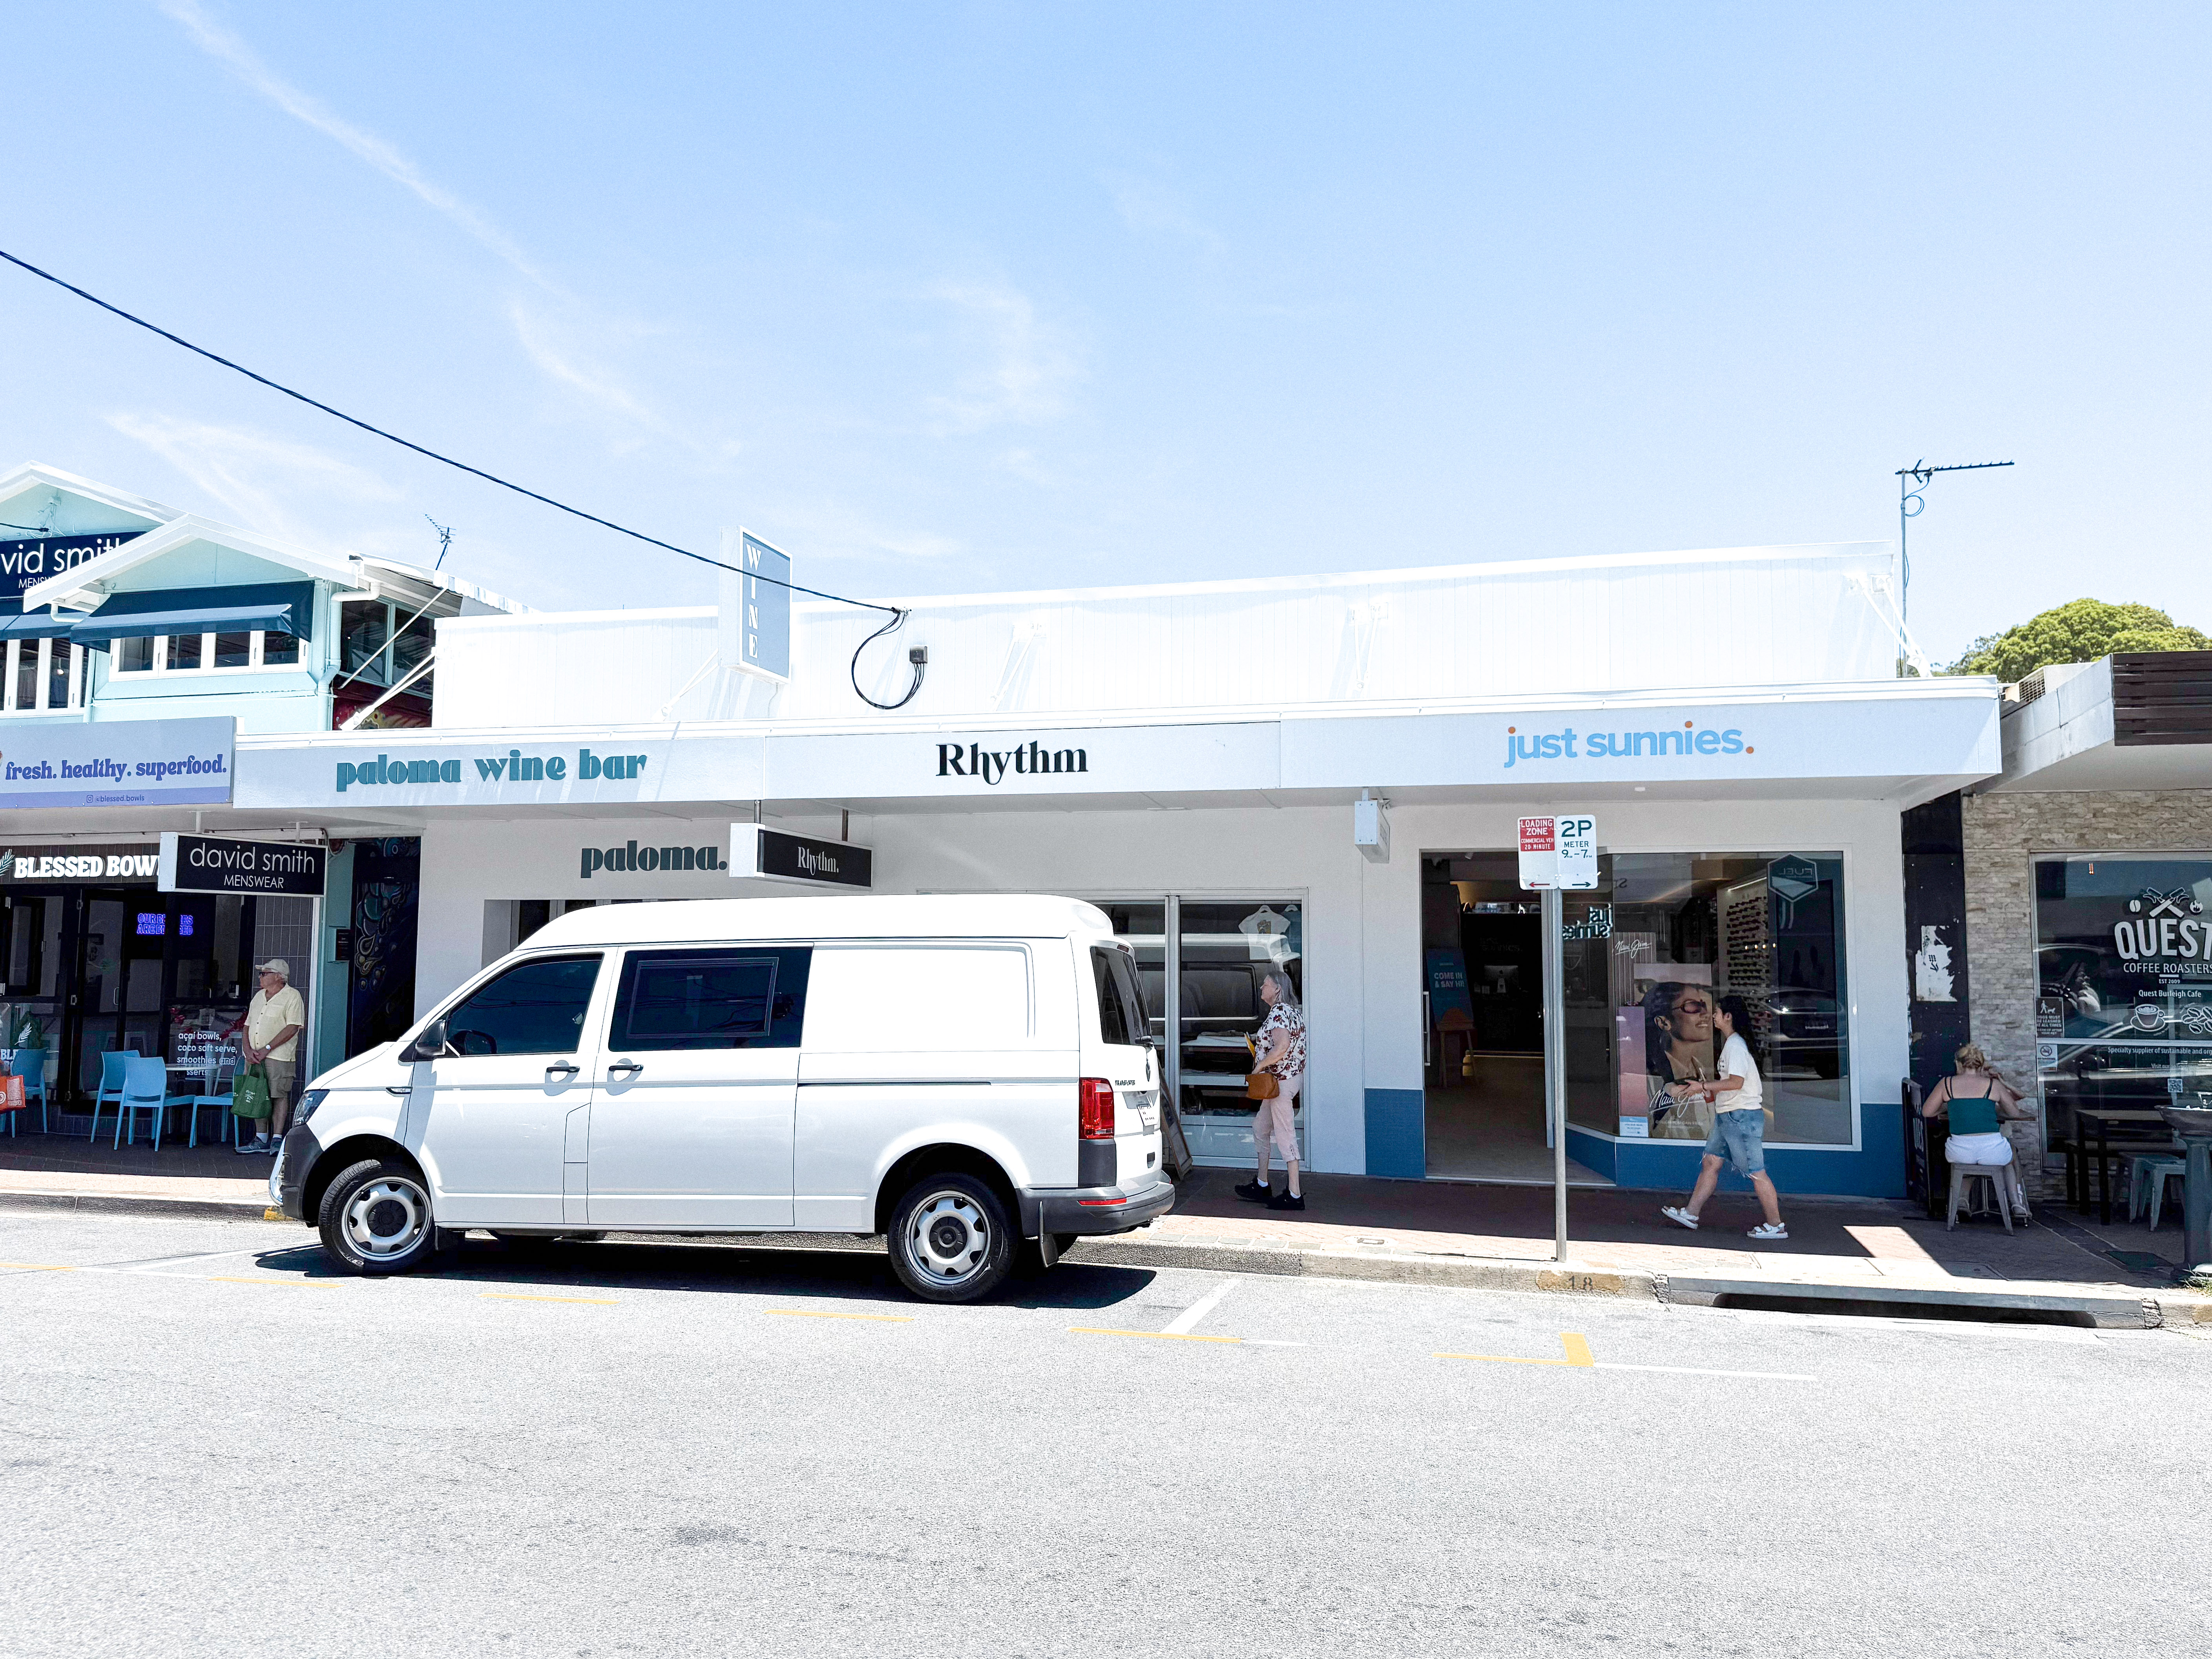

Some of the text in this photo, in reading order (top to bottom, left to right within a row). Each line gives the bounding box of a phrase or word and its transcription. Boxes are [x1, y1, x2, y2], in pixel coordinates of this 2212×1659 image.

[53, 538, 119, 571] smit
[746, 544, 761, 659] WINE
[1504, 721, 1754, 768] just sunnies.
[5, 754, 226, 783] fresh. healthy. superfood.
[336, 749, 648, 792] paloma wine bar
[936, 740, 1089, 785] Rhythm
[1521, 819, 1553, 828] LOADING
[1526, 827, 1548, 836] ZONE
[1561, 820, 1592, 837] 2P
[14, 856, 104, 878] BLESSED
[190, 843, 314, 874] david smith
[581, 840, 728, 878] paloma.
[798, 846, 839, 876] Rhythm.
[224, 874, 284, 889] MENSWEAR
[2114, 918, 2212, 960] QUEST
[2123, 963, 2160, 973] COFFEE
[2159, 989, 2186, 998] Burleigh
[197, 1032, 222, 1041] bowls,
[198, 1044, 213, 1052] soft
[177, 1056, 235, 1065] smoothies and
